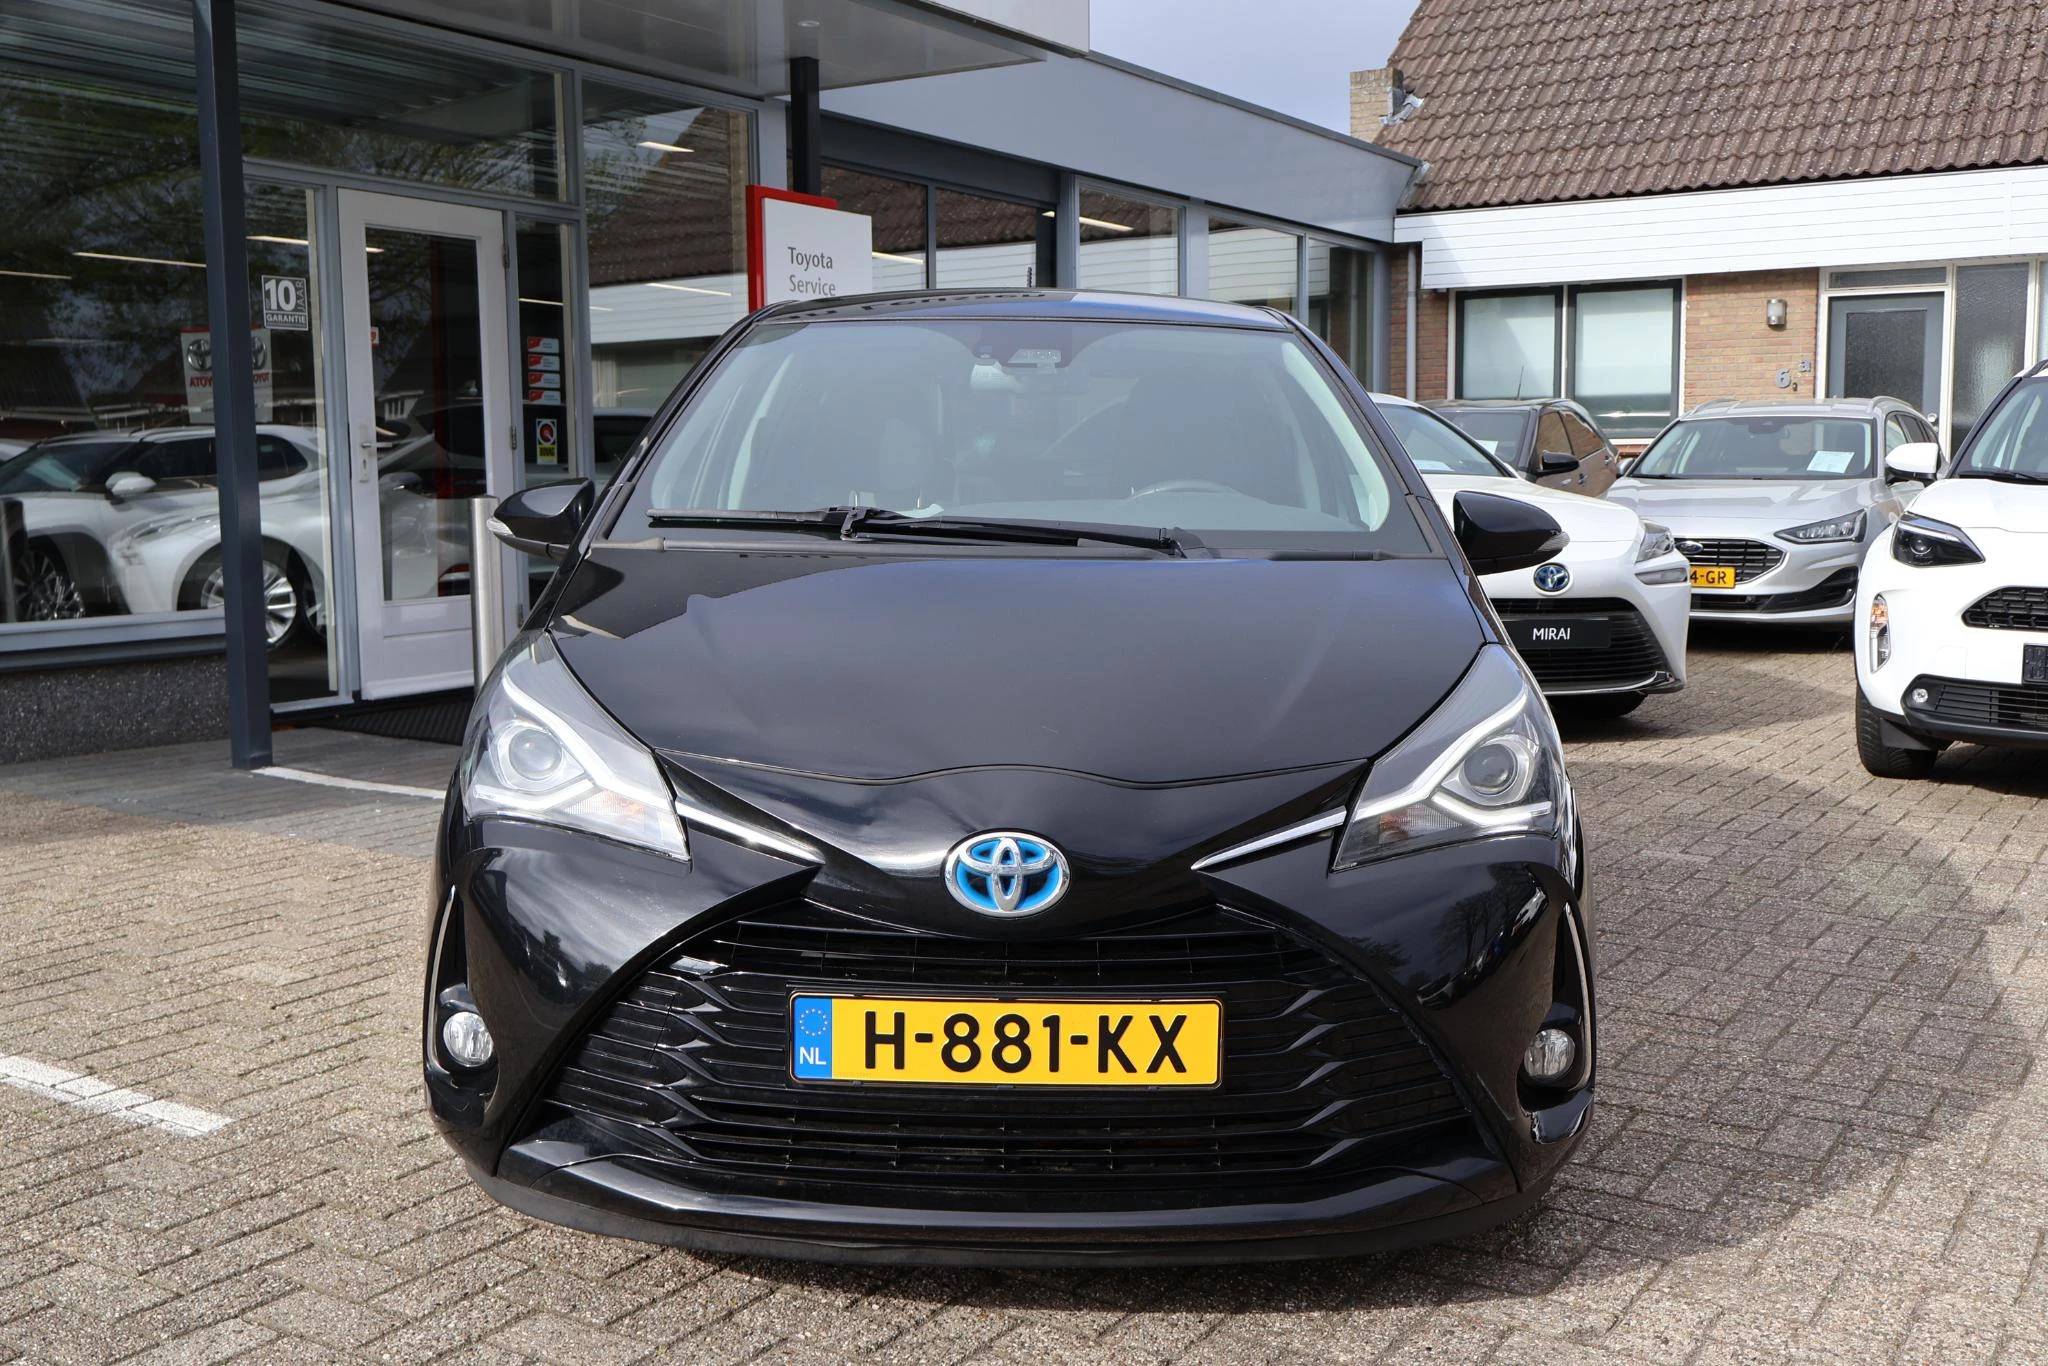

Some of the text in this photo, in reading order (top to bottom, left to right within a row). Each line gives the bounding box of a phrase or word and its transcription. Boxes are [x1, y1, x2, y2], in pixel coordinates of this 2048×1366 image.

[787, 246, 833, 271] Toyota
[265, 278, 297, 312] 10
[296, 280, 305, 312] JAAR
[789, 274, 836, 297] Service
[266, 313, 306, 324] GARANTIE
[1532, 627, 1571, 641] MIRAI
[864, 1010, 1189, 1075] H-881-KX
[799, 1047, 827, 1066] NL
